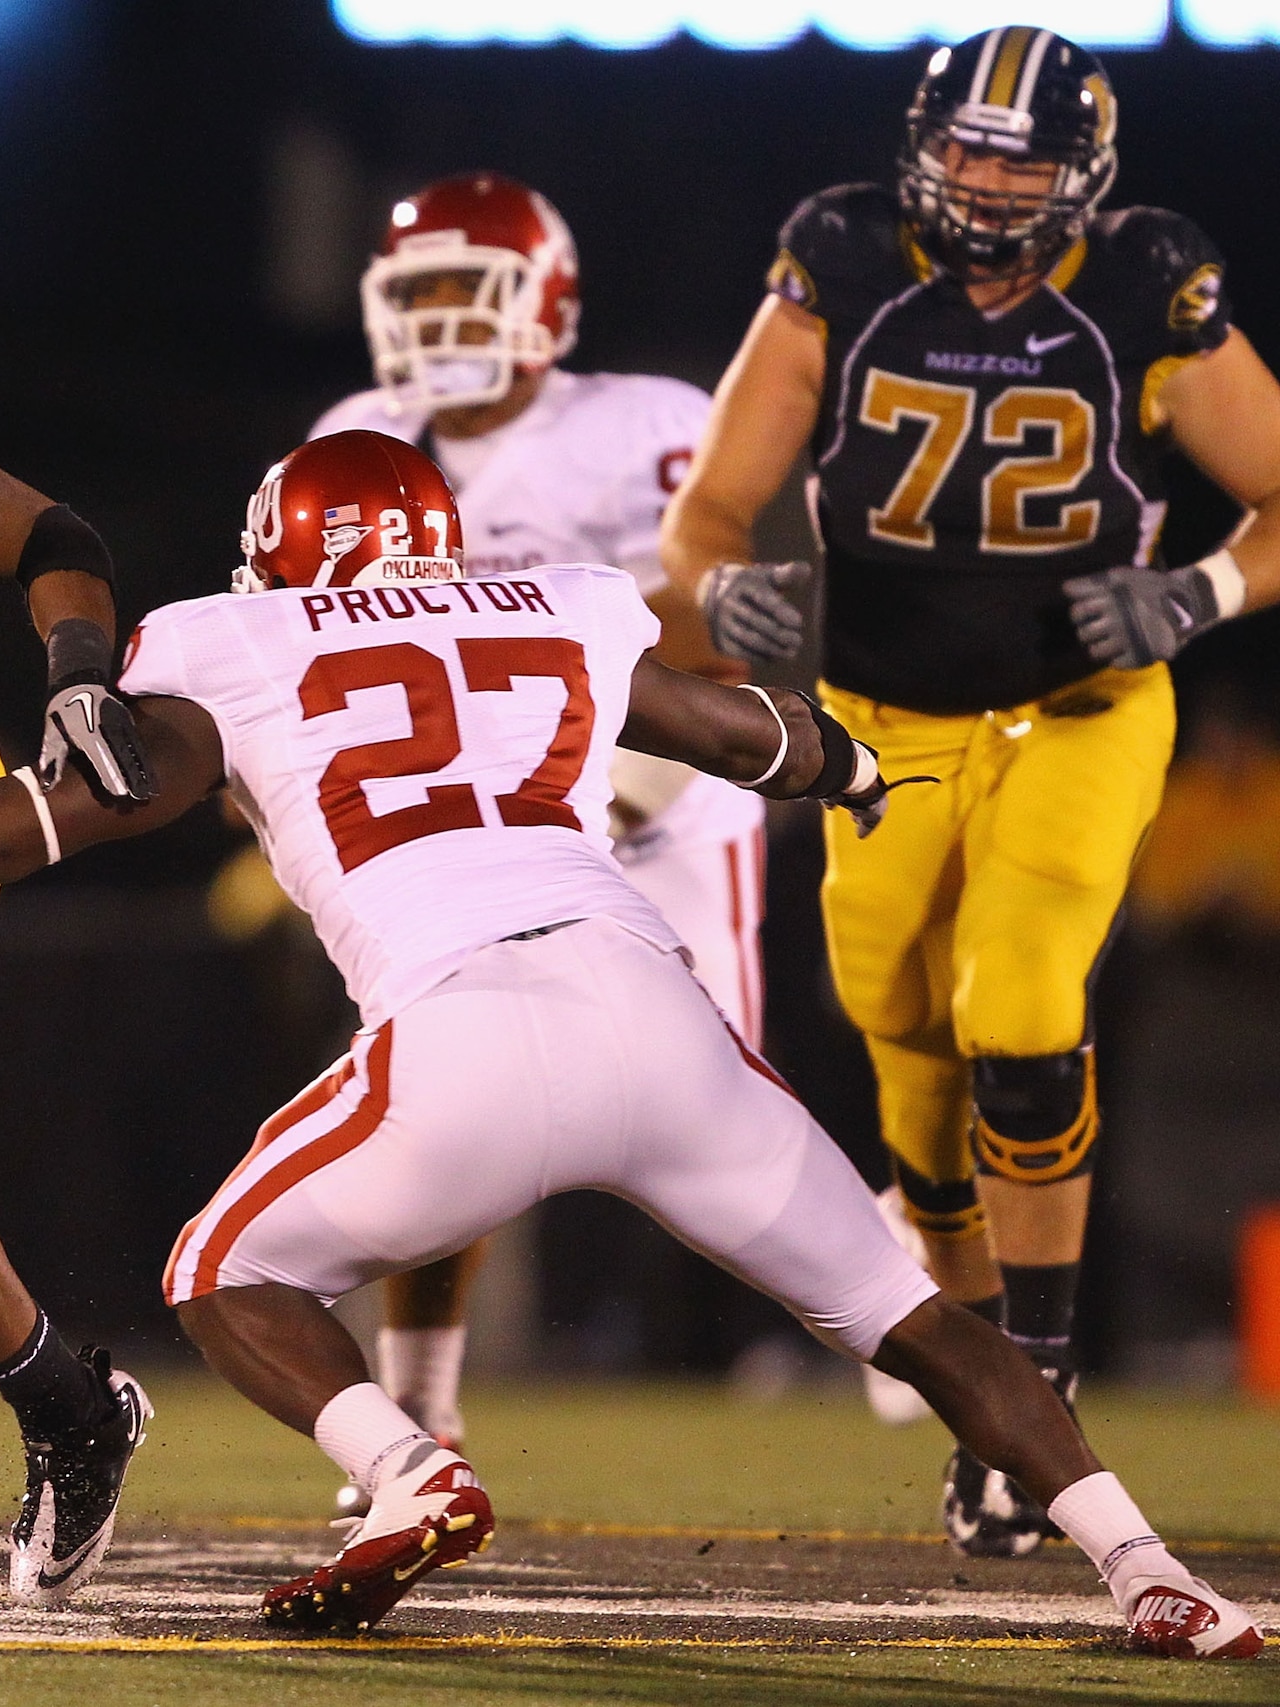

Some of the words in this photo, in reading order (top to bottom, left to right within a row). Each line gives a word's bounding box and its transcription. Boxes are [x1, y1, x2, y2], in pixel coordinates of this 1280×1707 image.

[924, 351, 1043, 377] MIZZOU
[858, 366, 1102, 555] 72
[378, 508, 449, 558] 27
[382, 560, 454, 581] OKLAHOMA
[300, 580, 557, 632] PROCTOR
[297, 636, 596, 876] 27
[1132, 1595, 1197, 1626] NIKE
